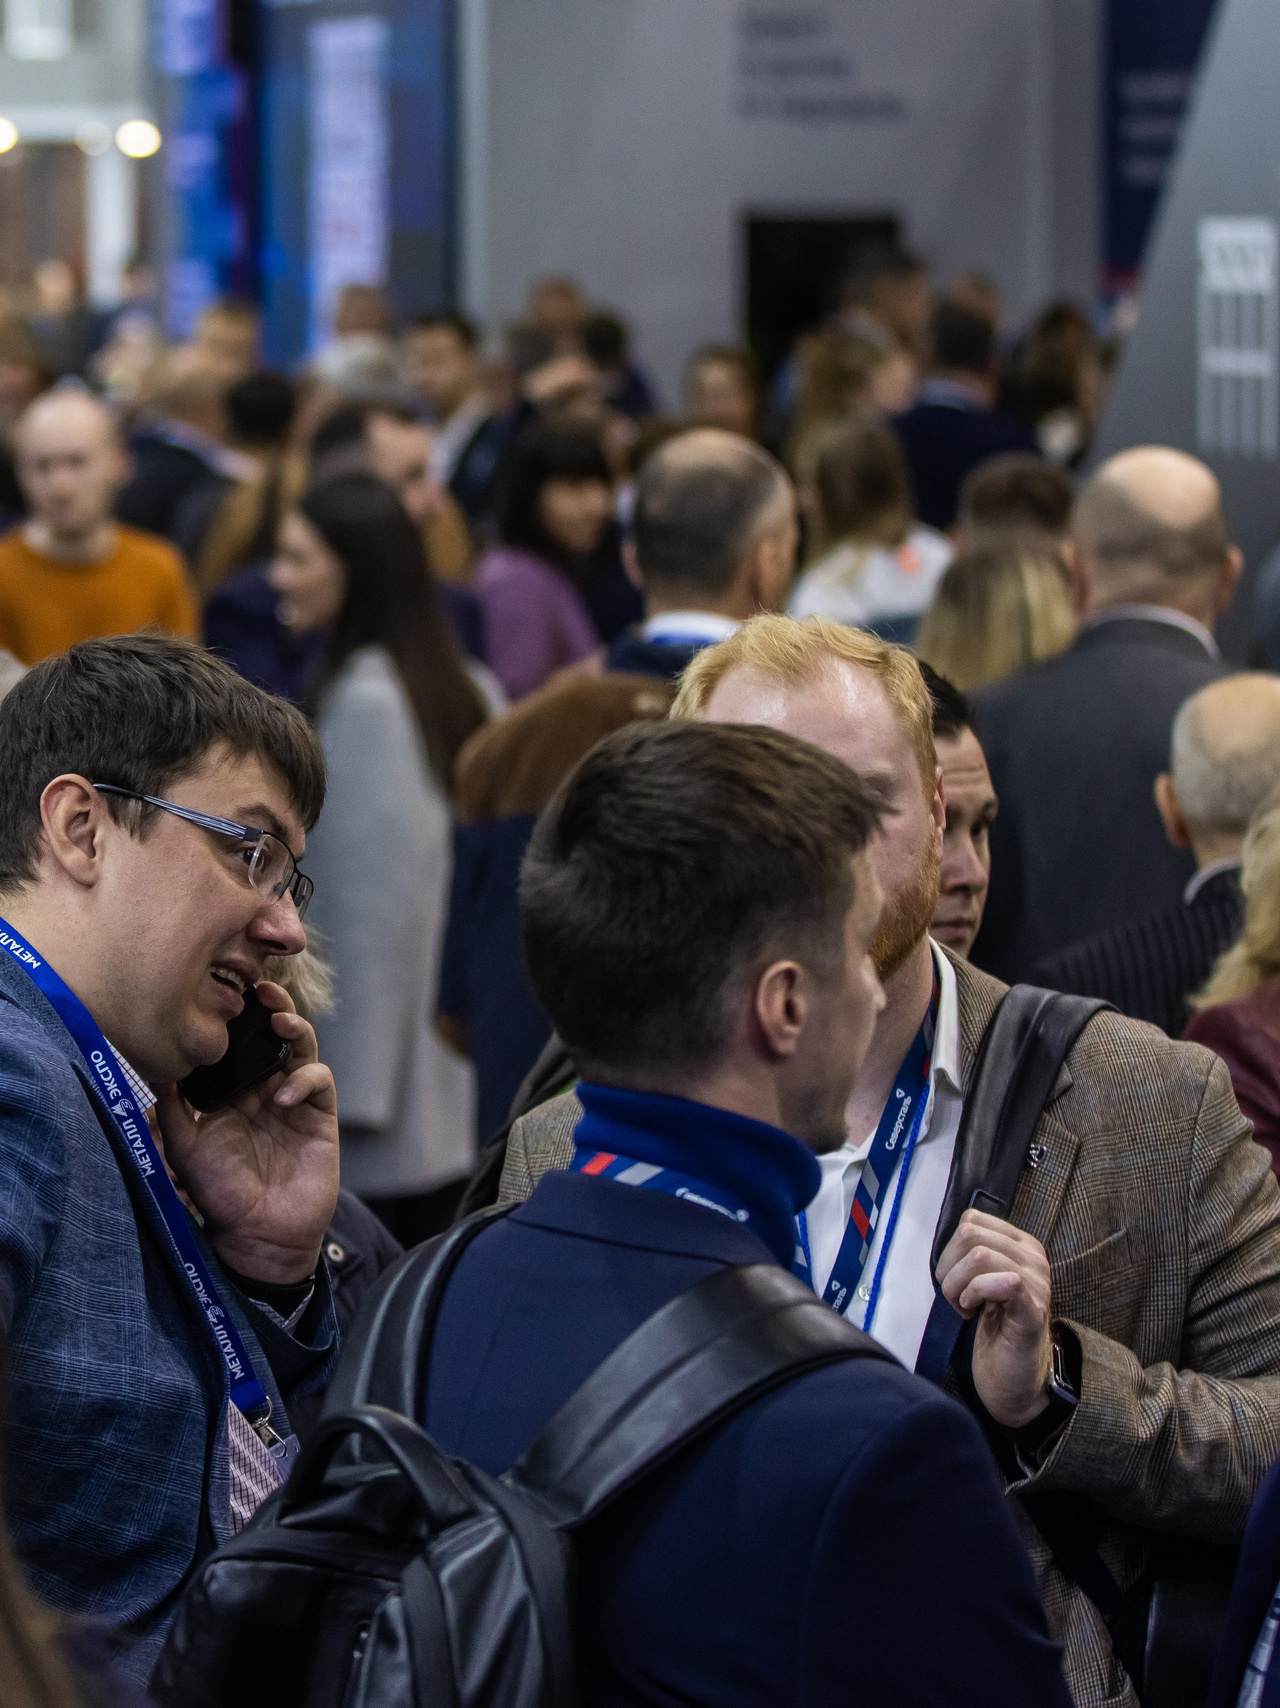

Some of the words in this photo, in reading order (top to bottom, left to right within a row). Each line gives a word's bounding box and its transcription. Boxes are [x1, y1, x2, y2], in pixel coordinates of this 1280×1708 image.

[90, 1050, 122, 1100] ЭКСПО
[122, 1118, 156, 1177] МЕТАЛЛ
[885, 1095, 912, 1151] Северсталь
[184, 1262, 213, 1308] ЭКСПО
[214, 1324, 245, 1381] МЕТАЛЛ
